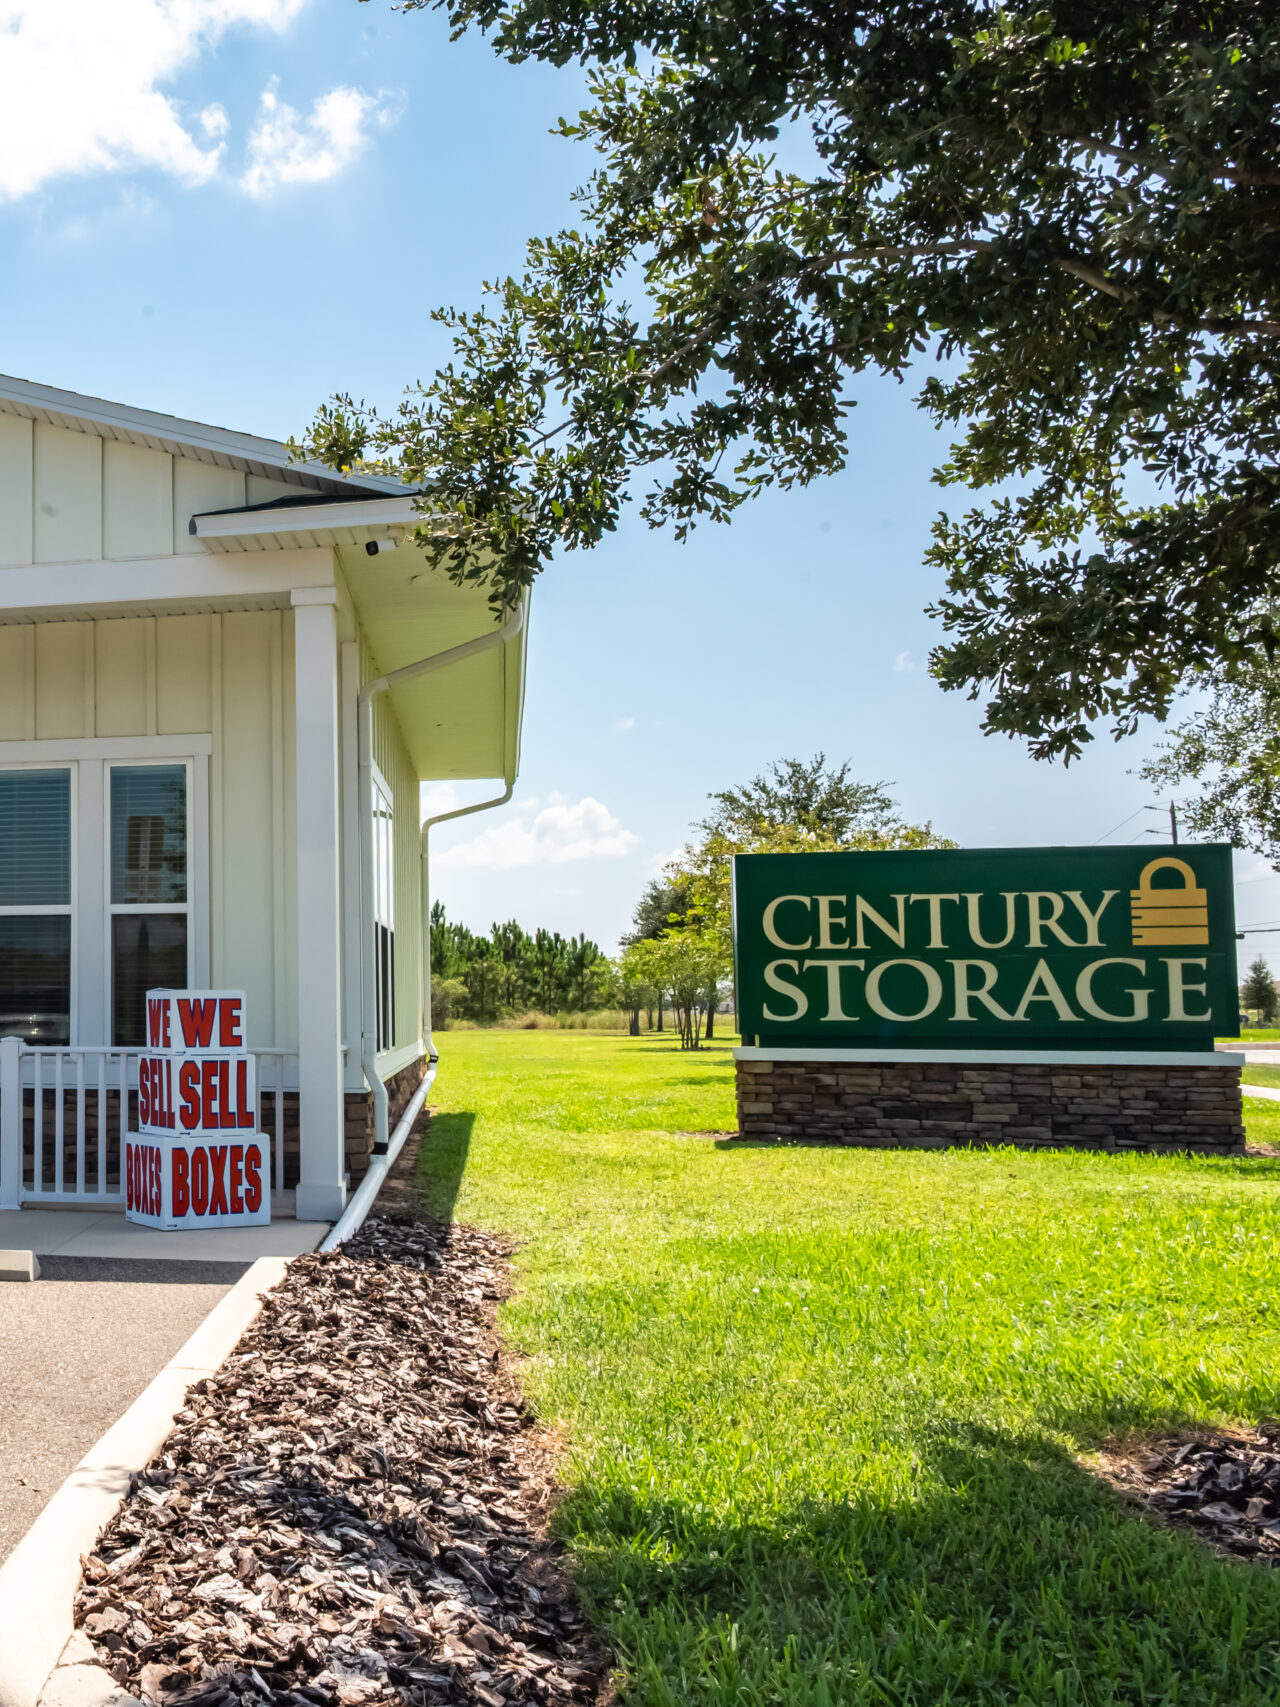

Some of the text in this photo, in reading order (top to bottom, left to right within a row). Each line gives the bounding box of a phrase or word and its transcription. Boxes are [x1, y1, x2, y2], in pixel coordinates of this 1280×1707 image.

[762, 890, 1120, 951] CENTURY
[147, 998, 171, 1048] WE
[176, 998, 243, 1048] WE
[762, 957, 1212, 1022] STORAGE
[139, 1058, 175, 1129] SELL
[179, 1060, 255, 1130] SELL
[126, 1143, 162, 1218] BOXES
[171, 1144, 262, 1217] BOXES
